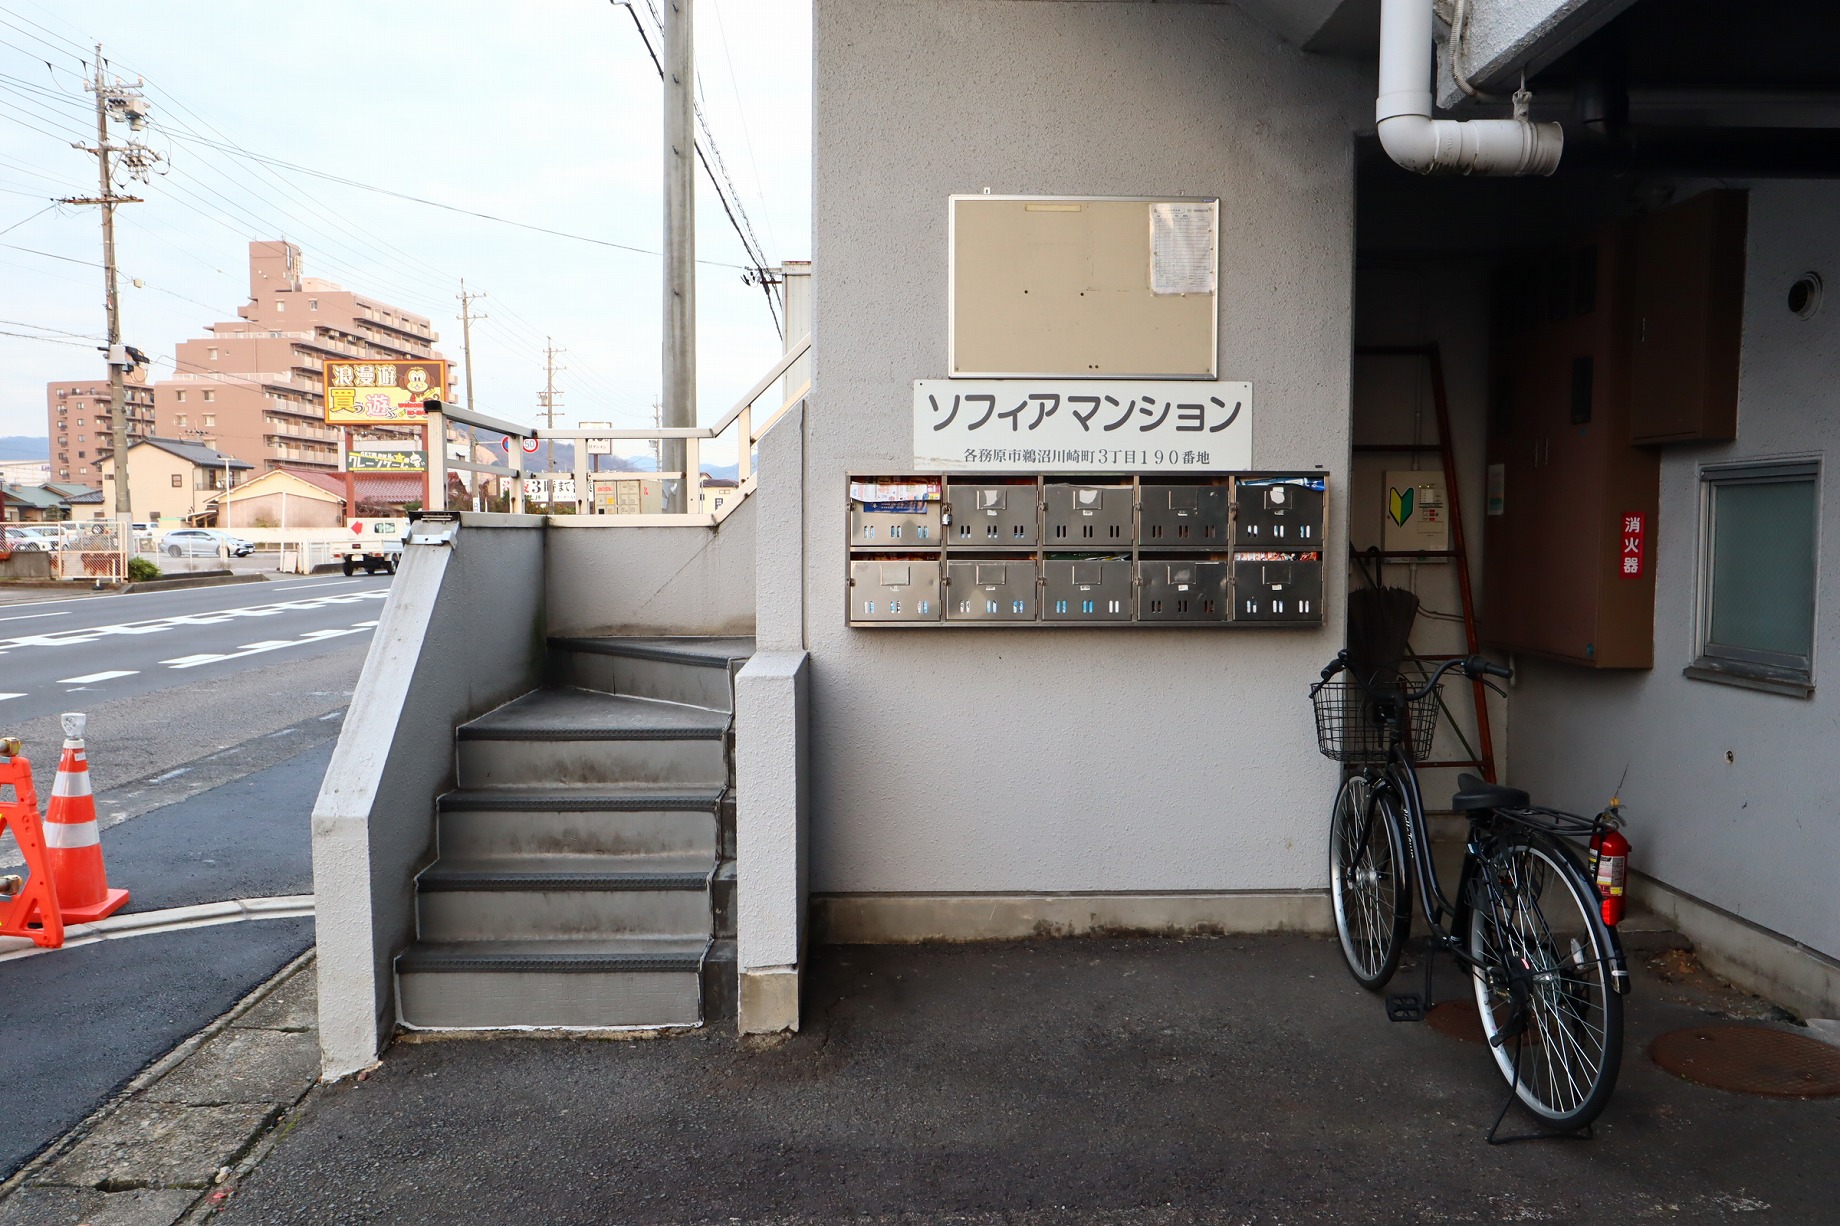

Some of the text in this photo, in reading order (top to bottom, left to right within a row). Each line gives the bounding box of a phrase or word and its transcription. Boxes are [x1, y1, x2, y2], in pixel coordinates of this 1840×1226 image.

[332, 364, 397, 387] 浪漫遊
[330, 388, 398, 419] 買う 遊ぶ
[928, 393, 1242, 433] ソフィアマンション
[524, 439, 535, 448] 50
[1623, 516, 1641, 574] 消火器
